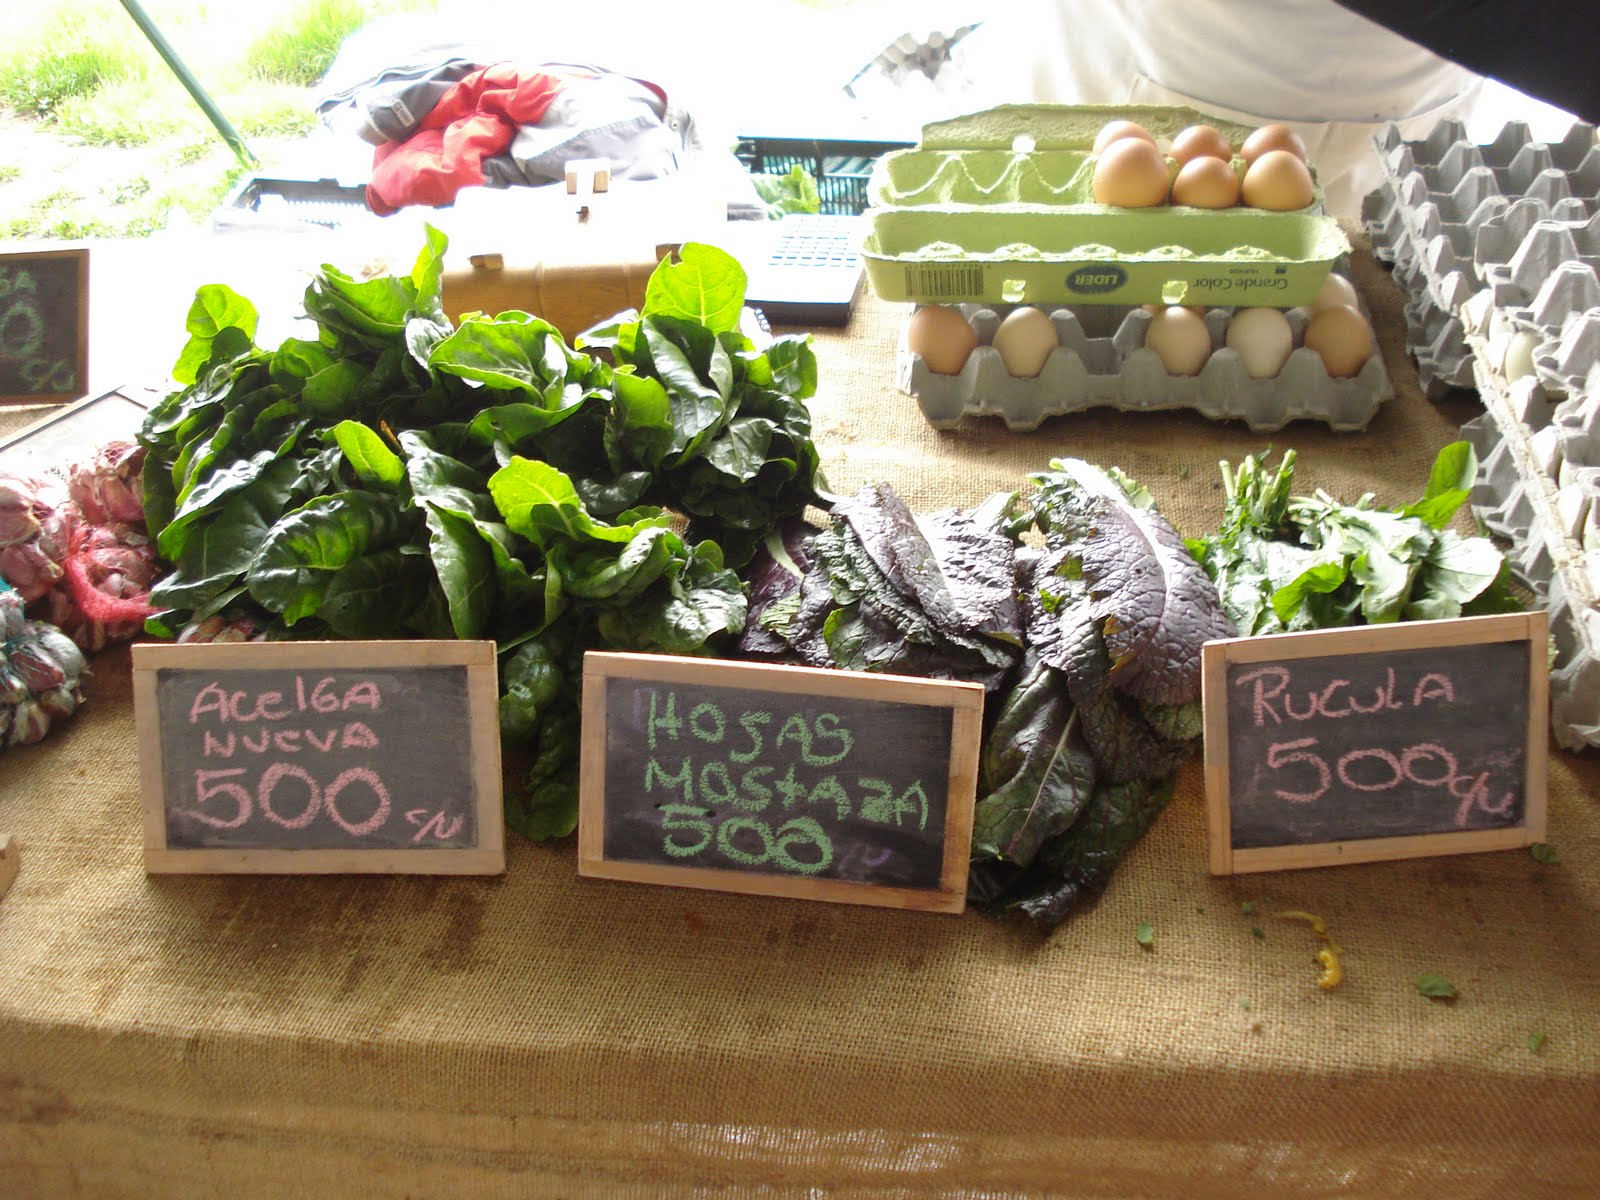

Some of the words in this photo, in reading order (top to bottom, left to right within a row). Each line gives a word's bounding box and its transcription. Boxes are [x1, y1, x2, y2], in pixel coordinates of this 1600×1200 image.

[1074, 273, 1120, 286] LIDER
[1192, 276, 1233, 289] Color
[1234, 277, 1289, 290] Grande
[1267, 737, 1457, 802] 500
[172, 761, 392, 837] 500
[658, 803, 834, 875] 500
